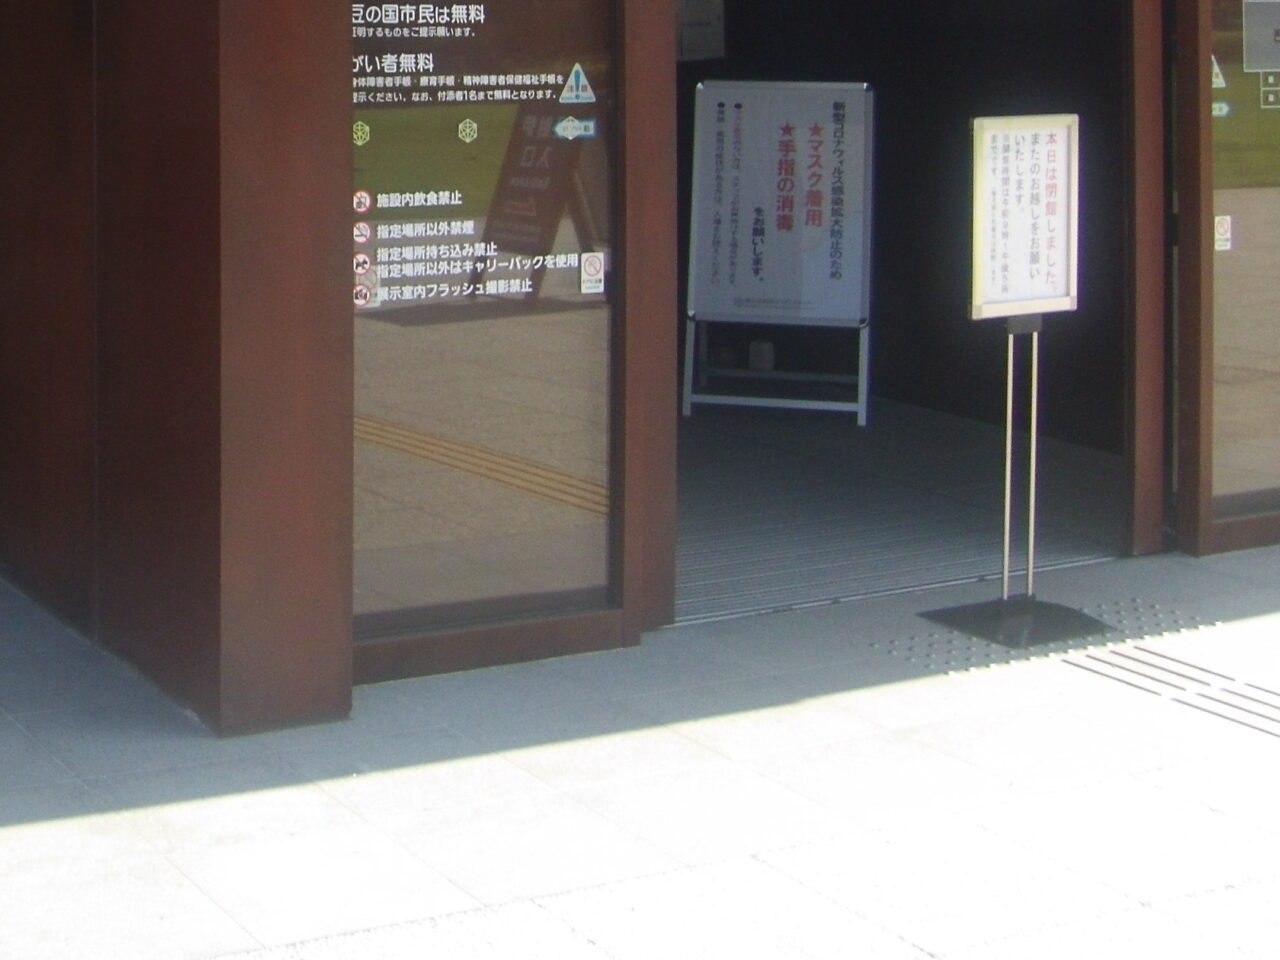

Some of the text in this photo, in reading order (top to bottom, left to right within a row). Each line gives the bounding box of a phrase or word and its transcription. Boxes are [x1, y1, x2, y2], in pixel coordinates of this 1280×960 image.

[376, 190, 463, 208] 施設内飲食禁止
[376, 220, 474, 239] 指定場所以外禁煙
